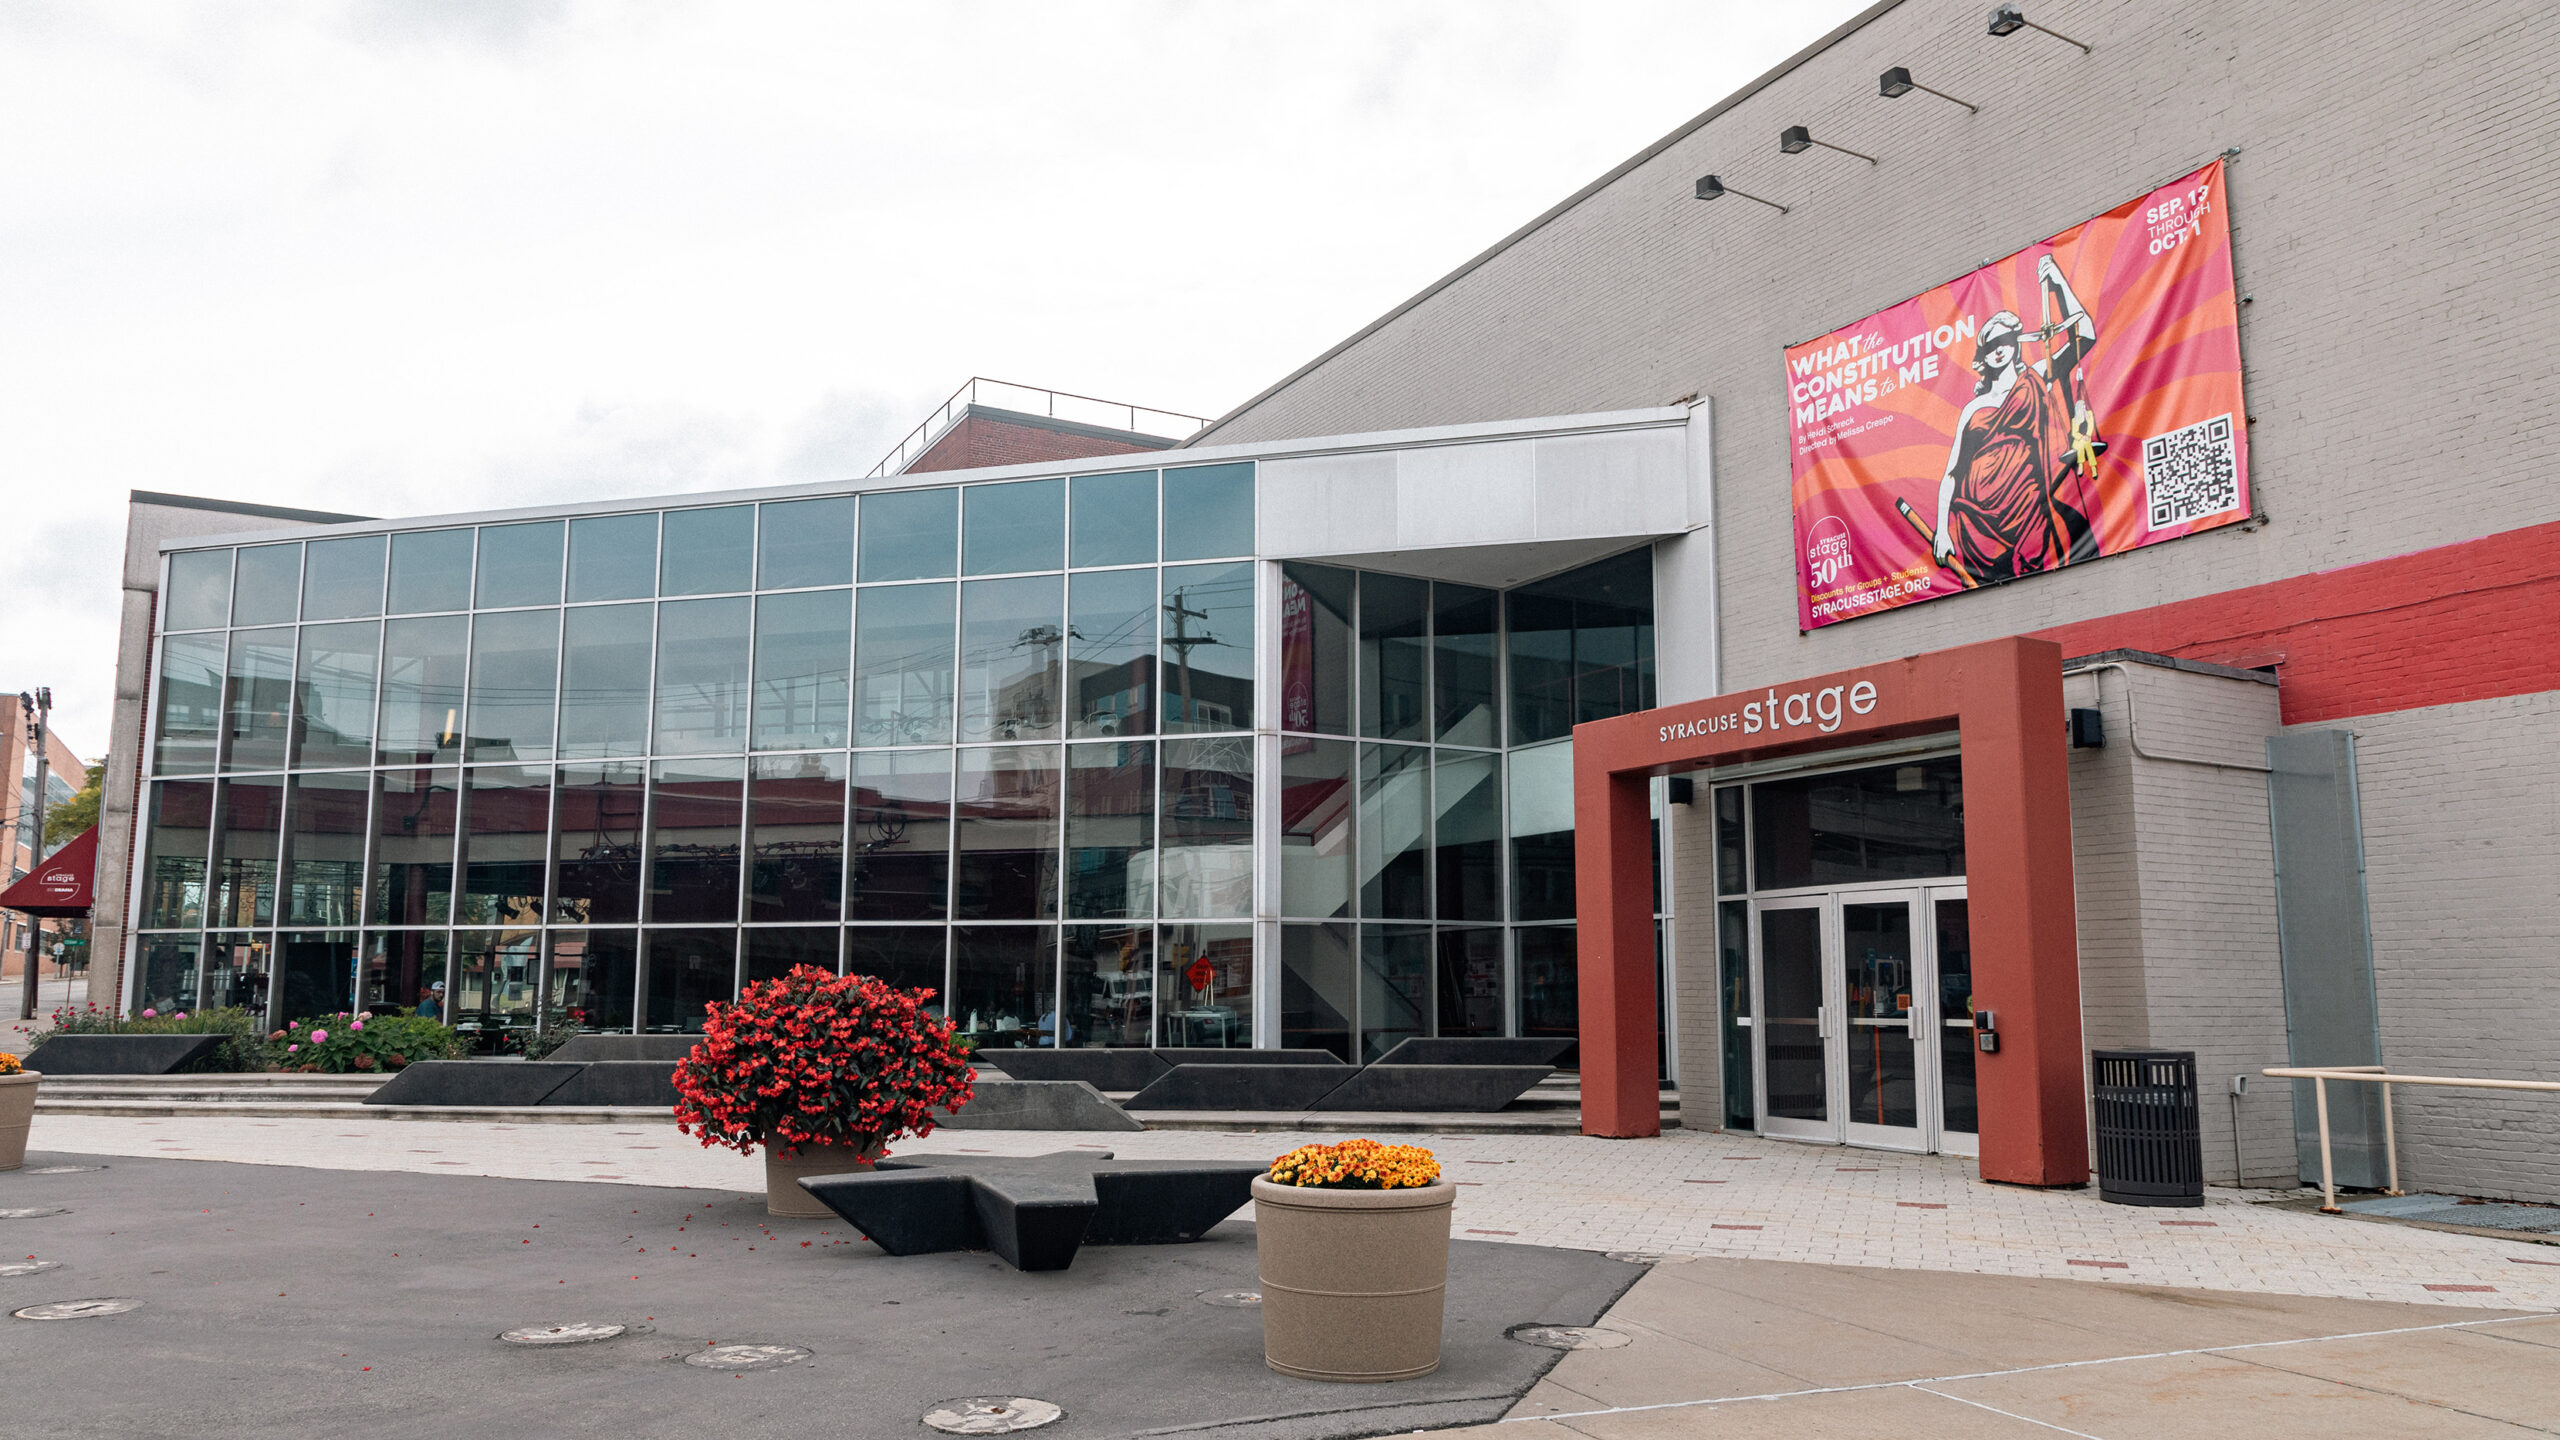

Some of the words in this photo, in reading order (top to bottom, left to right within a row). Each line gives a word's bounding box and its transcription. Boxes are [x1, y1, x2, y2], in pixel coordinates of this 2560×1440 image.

[2146, 197, 2184, 224] SEP.
[2188, 185, 2209, 206] 13
[2147, 201, 2211, 238] THROUGH
[2149, 227, 2188, 255] OCT.
[2191, 220, 2201, 236] 1
[1792, 334, 1862, 379] WHAT
[1862, 331, 1885, 351] the
[1793, 315, 1975, 403] CONSTITUTION
[1796, 379, 1878, 429] MEANS
[1879, 376, 1898, 397] to
[1899, 354, 1939, 389] ME
[1798, 434, 1807, 445] By
[1807, 425, 1827, 441] Heidi
[1827, 416, 1855, 433] Schreck
[1799, 438, 1827, 456] Directed
[1828, 432, 1837, 445] by
[1837, 424, 1865, 441] Melissa
[1865, 414, 1894, 431] Crespo
[1809, 538, 1848, 559] stage
[1820, 532, 1846, 545] SYRACUSE
[1810, 549, 1854, 588] 50th
[1810, 587, 1844, 603] Discounts
[1845, 585, 1855, 594] for
[1857, 578, 1882, 591] Groups
[1890, 566, 1929, 581] Students
[1811, 576, 1931, 618] SYRACUSESTAGE.ORG
[1659, 712, 1739, 743] SYRACUSE
[1743, 680, 1878, 733] stage
